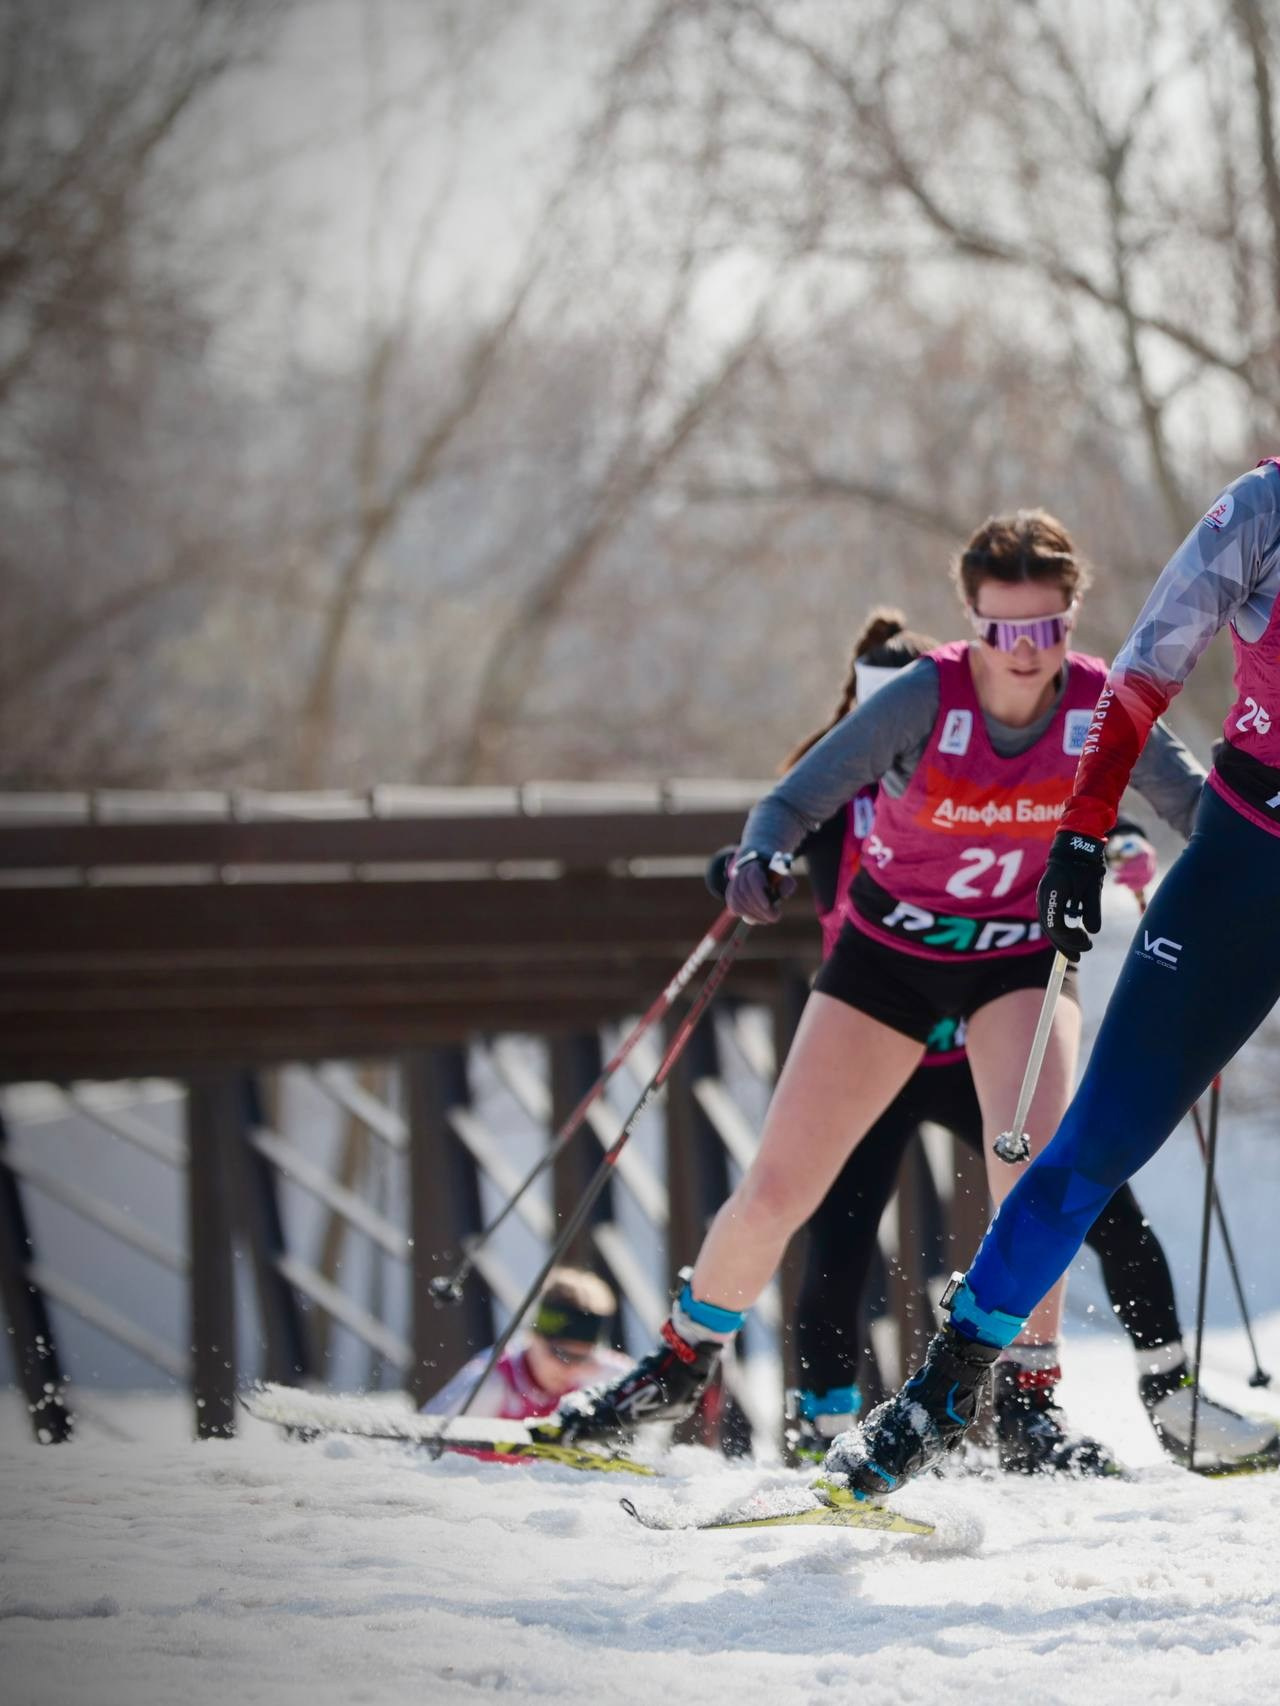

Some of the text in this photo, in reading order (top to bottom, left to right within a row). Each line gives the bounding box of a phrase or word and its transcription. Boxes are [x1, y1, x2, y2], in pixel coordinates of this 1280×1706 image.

[1084, 689, 1115, 755] ЗОРКИЙ
[1235, 697, 1272, 735] 25
[932, 798, 1012, 829] Альфа
[945, 847, 1024, 900] 21
[1047, 889, 1058, 928] adidas
[1144, 930, 1184, 963] VC
